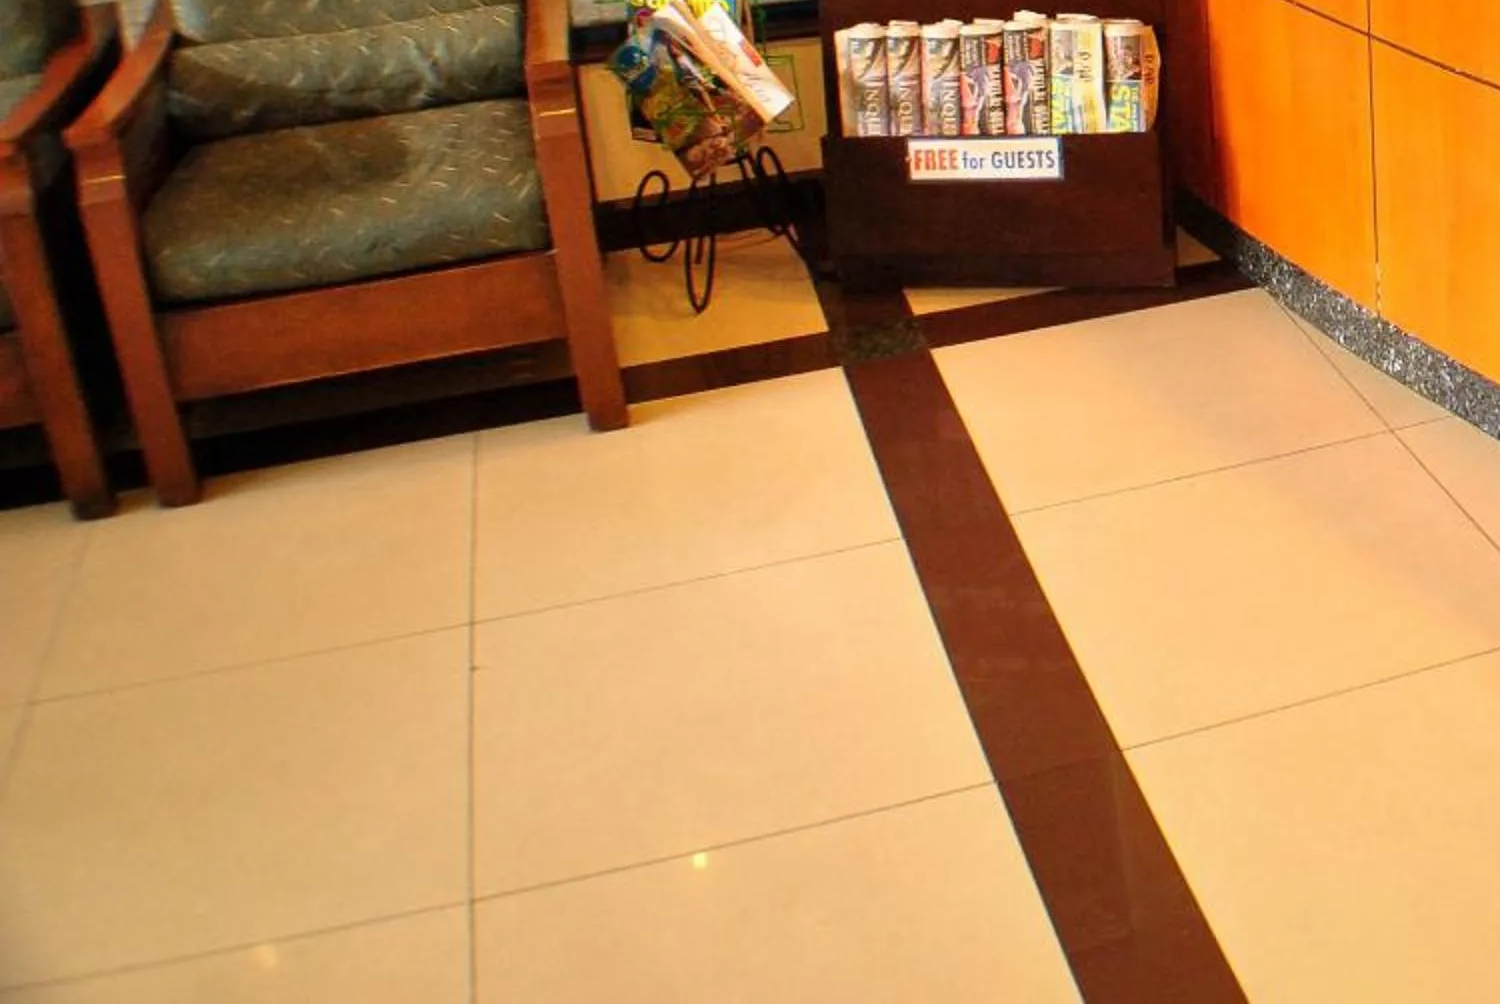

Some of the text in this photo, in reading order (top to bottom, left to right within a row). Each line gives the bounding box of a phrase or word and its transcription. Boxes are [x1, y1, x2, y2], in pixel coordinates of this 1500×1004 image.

[913, 148, 1055, 170] FREE for GUESTS
